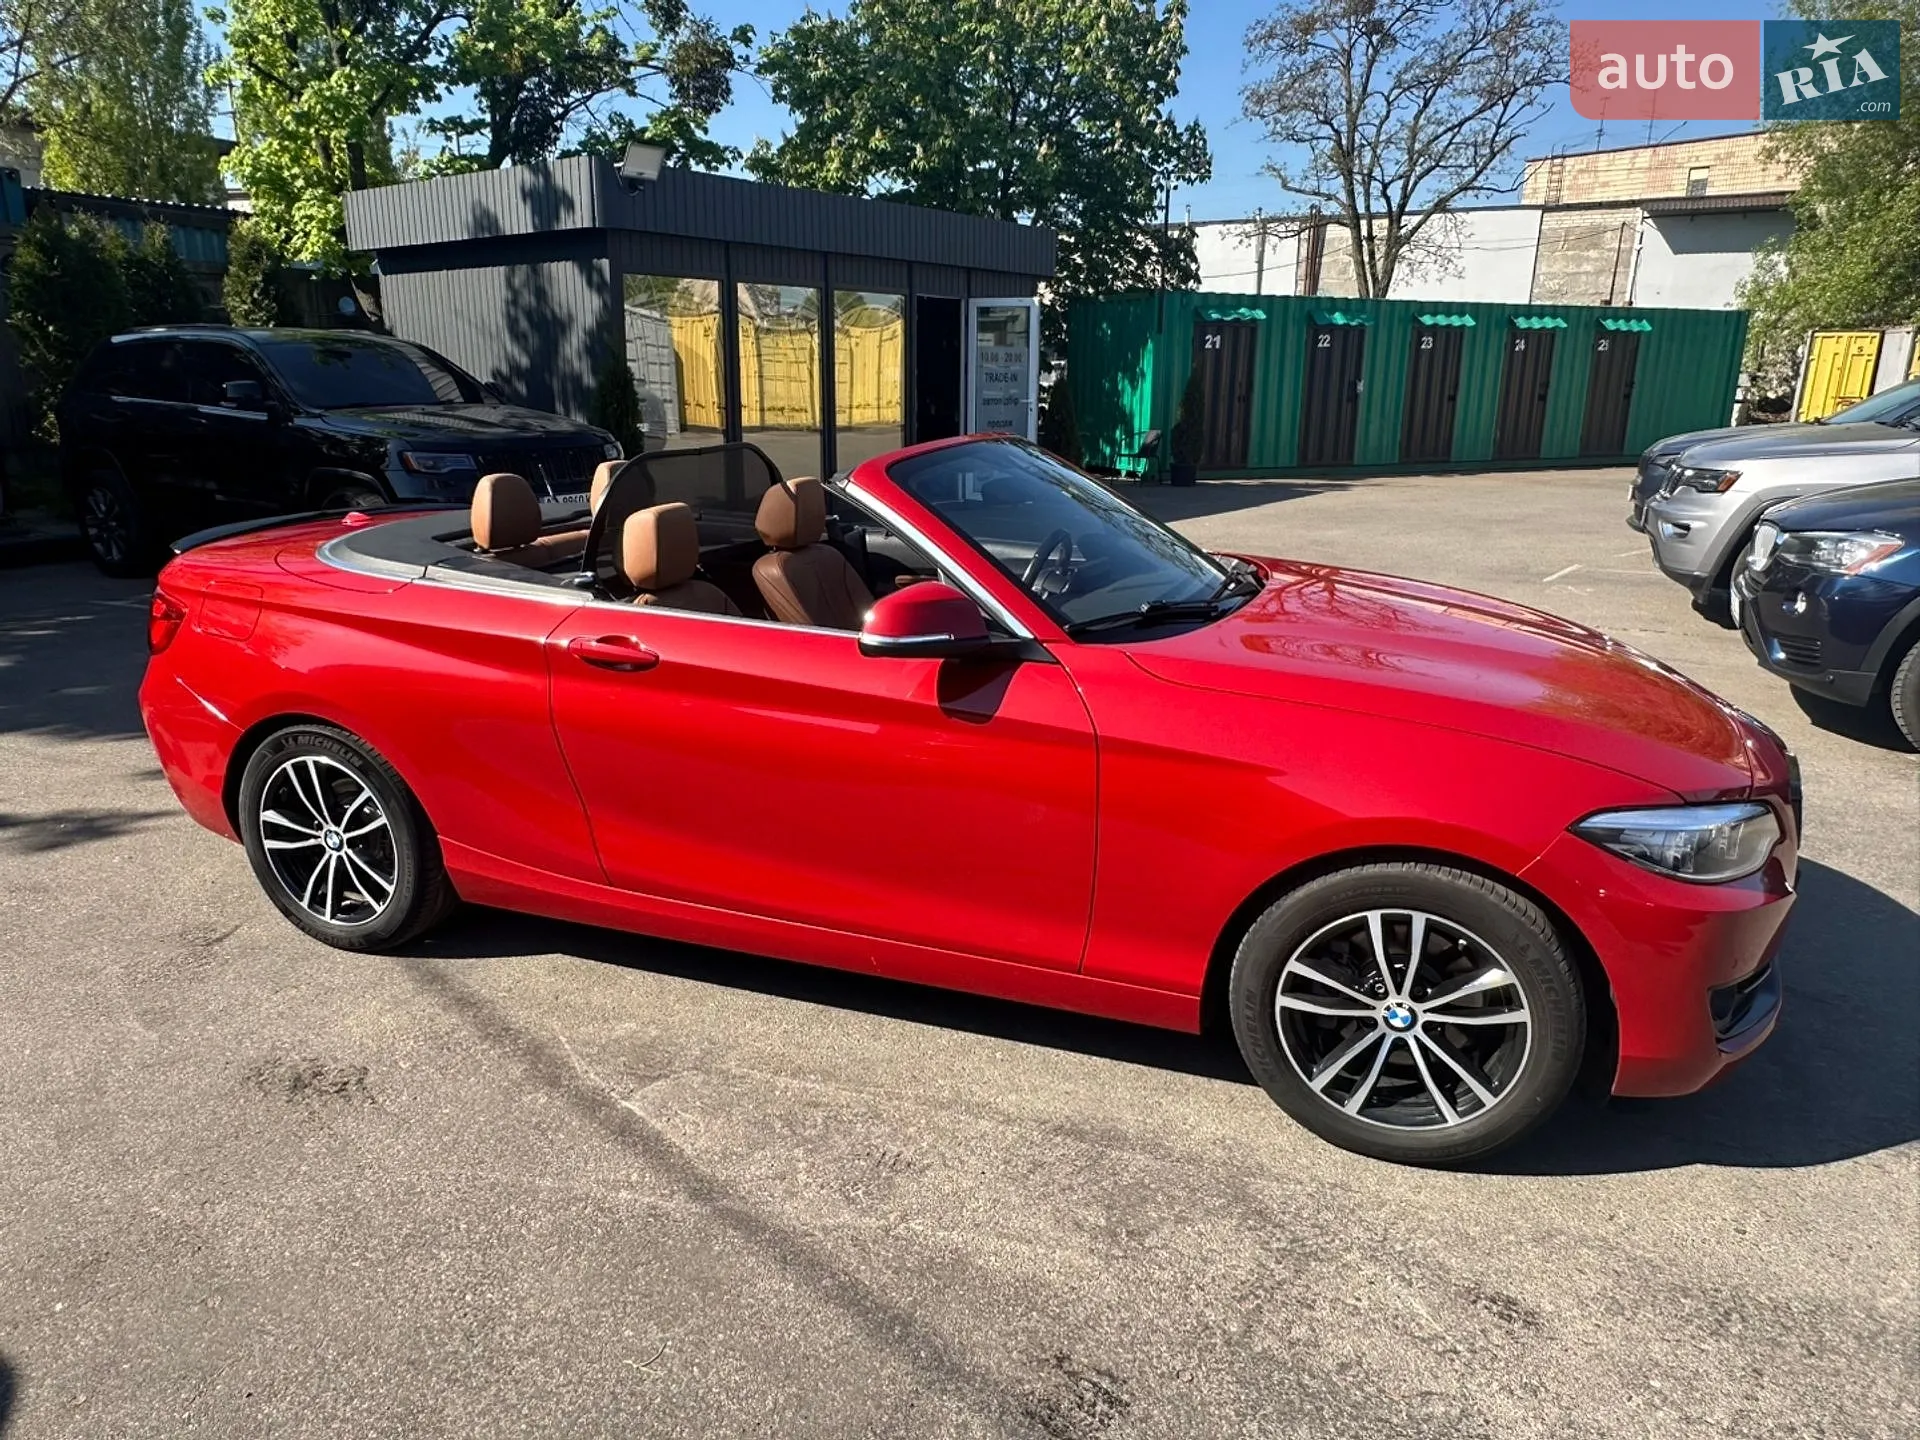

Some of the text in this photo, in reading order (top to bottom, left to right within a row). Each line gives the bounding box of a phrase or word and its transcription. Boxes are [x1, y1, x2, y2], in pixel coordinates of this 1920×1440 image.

[1204, 334, 1222, 349] 21
[1317, 334, 1331, 348] 22
[1420, 336, 1433, 349] 23
[1514, 338, 1526, 351] 24
[984, 371, 1018, 383] TRADE-IN
[297, 735, 363, 767] MICHELIN
